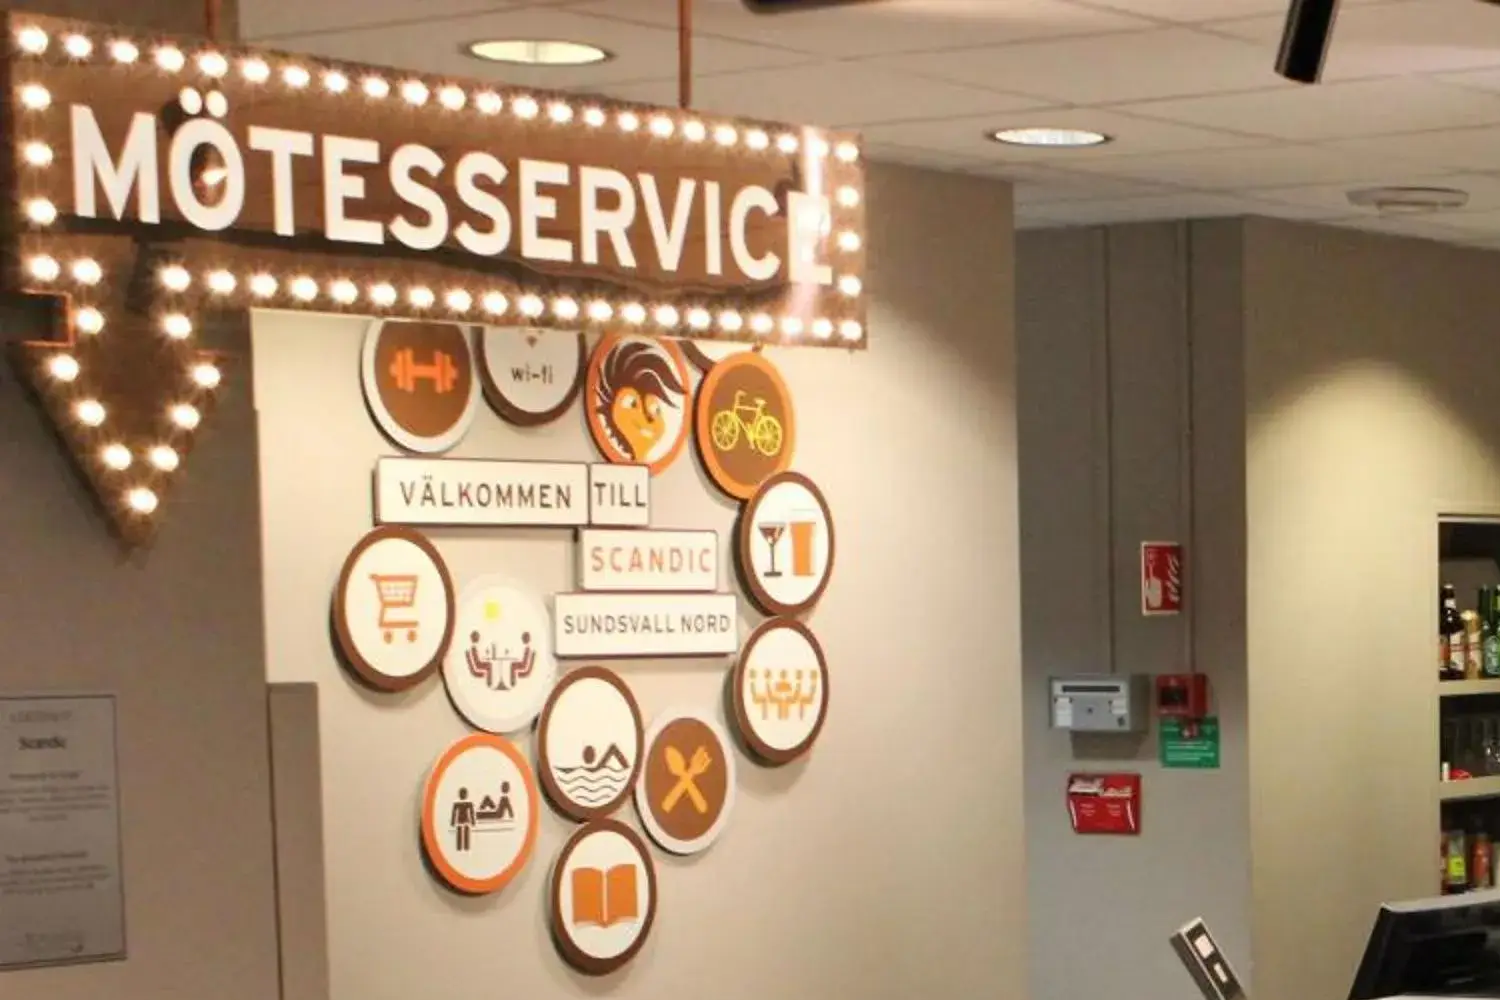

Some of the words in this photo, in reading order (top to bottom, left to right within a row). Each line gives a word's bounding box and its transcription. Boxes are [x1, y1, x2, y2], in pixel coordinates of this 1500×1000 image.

[69, 87, 833, 286] MÖTESSERVICE
[399, 475, 573, 508] VÄLKOMMEN
[594, 482, 648, 508] TILL
[590, 545, 713, 573] SCANDIC
[563, 613, 676, 635] SUNDSVALL
